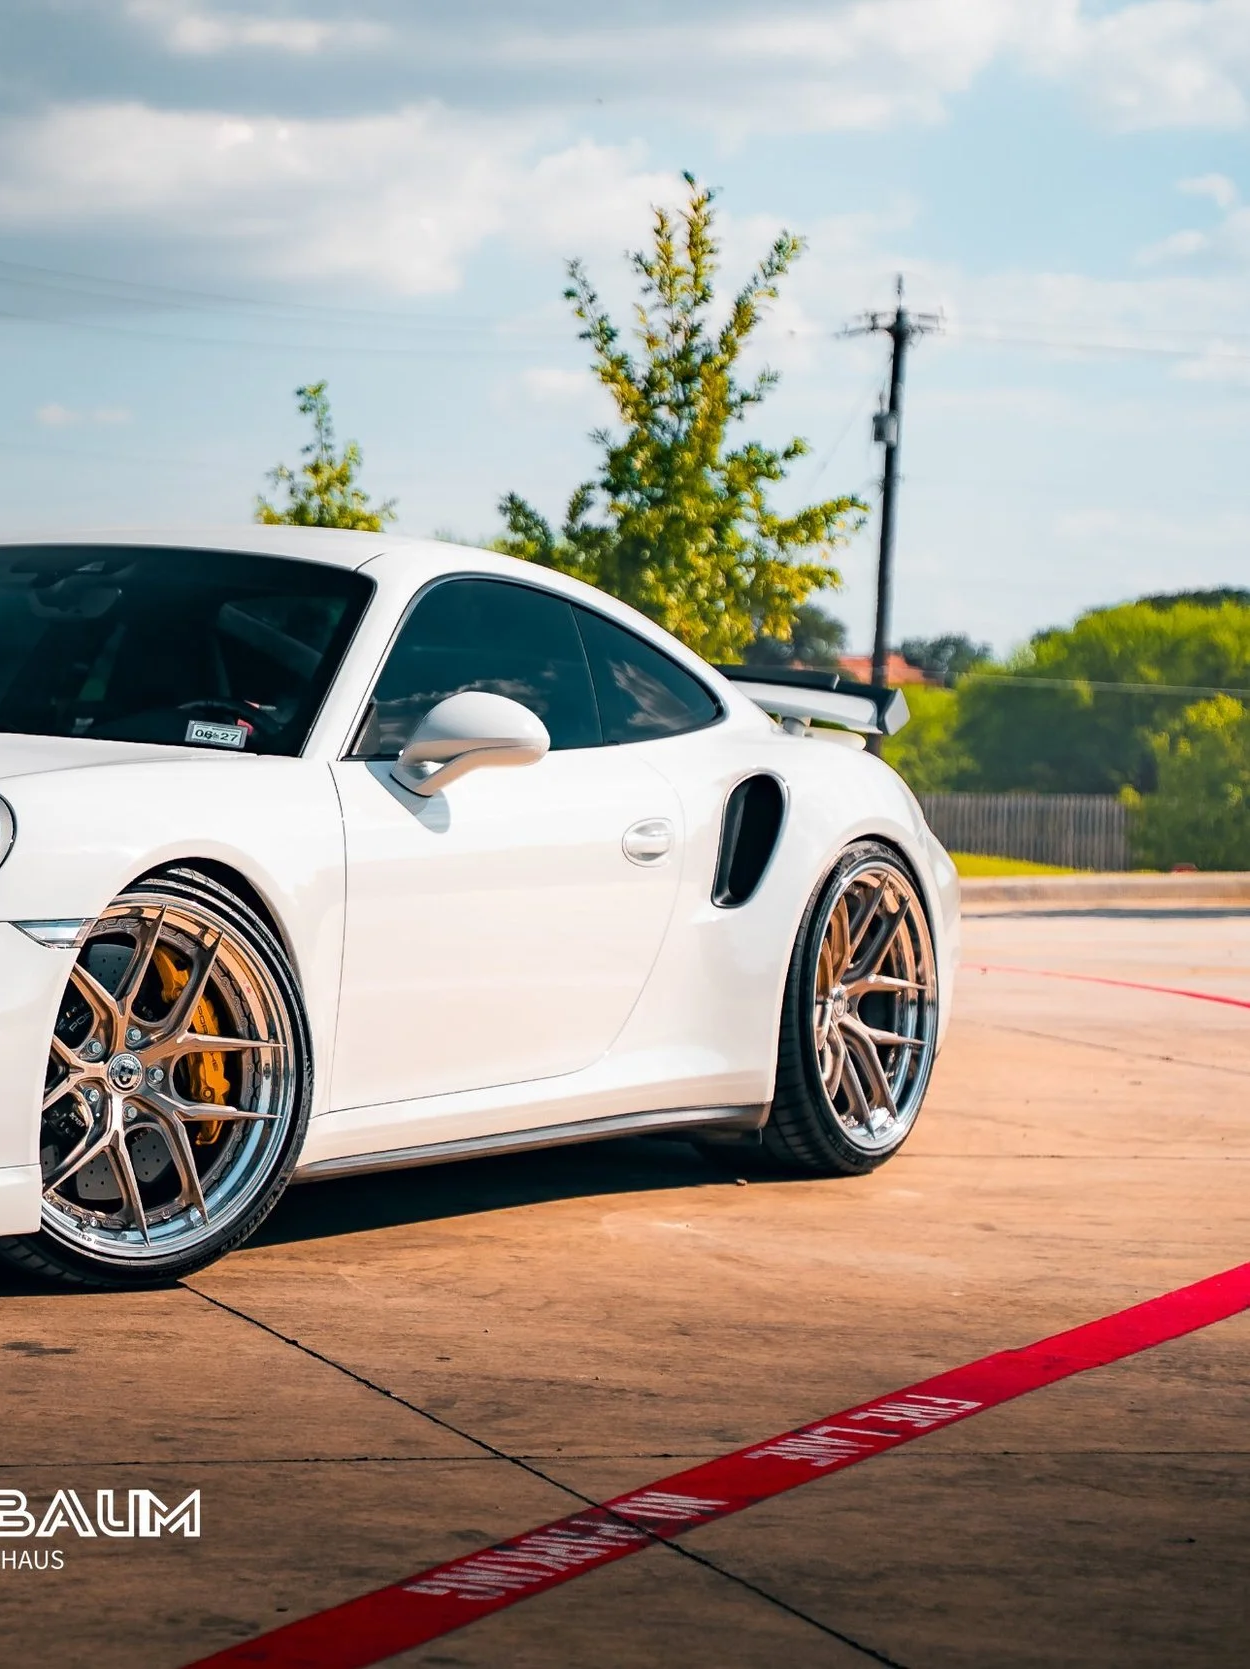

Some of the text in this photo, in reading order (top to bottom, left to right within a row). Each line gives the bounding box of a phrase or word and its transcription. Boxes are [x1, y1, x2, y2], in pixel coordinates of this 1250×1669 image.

[220, 732, 238, 742] 27
[743, 1394, 983, 1467] FIRE LANE
[402, 1490, 731, 1600] NO PARKING
